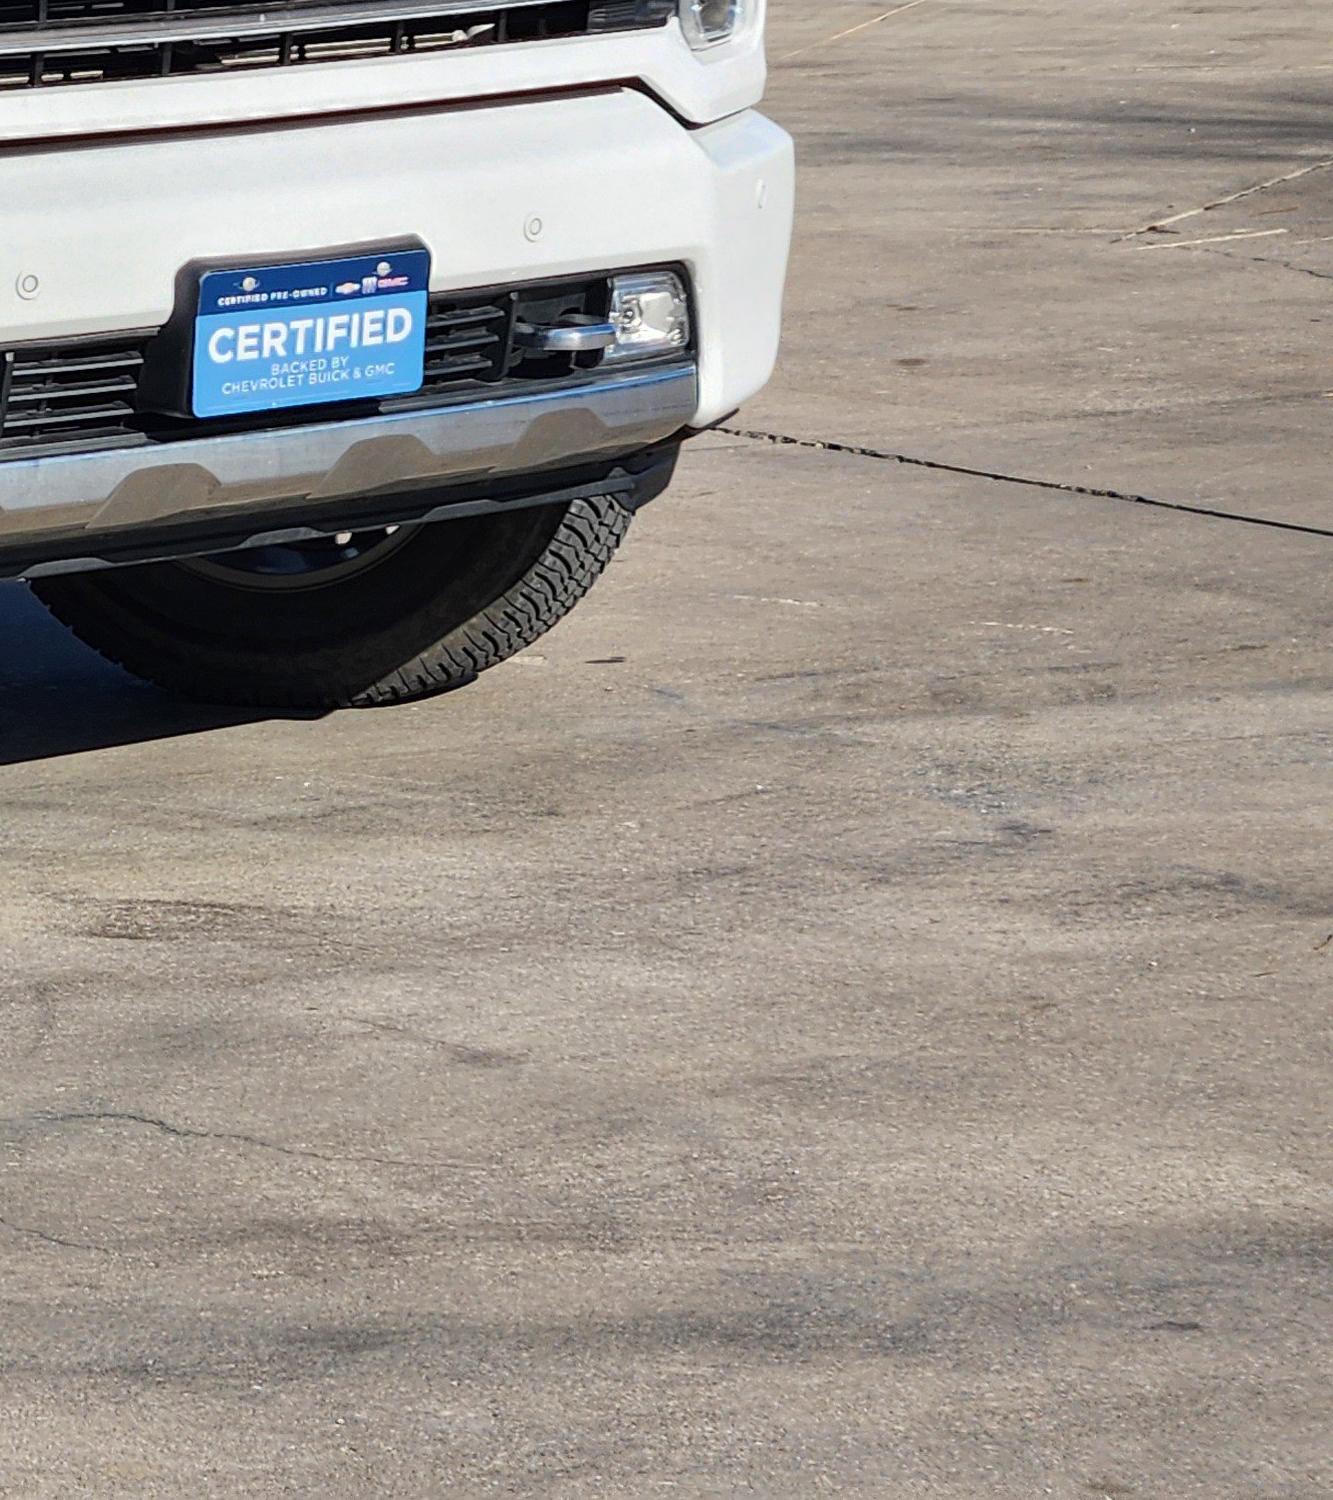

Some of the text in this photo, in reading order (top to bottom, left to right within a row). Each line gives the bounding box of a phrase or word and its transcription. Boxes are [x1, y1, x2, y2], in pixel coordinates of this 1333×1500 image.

[208, 307, 413, 364] CERTIFIED
[221, 362, 396, 395] CHEVROLET BUICK & GMC
[271, 355, 350, 376] BACKED BY
